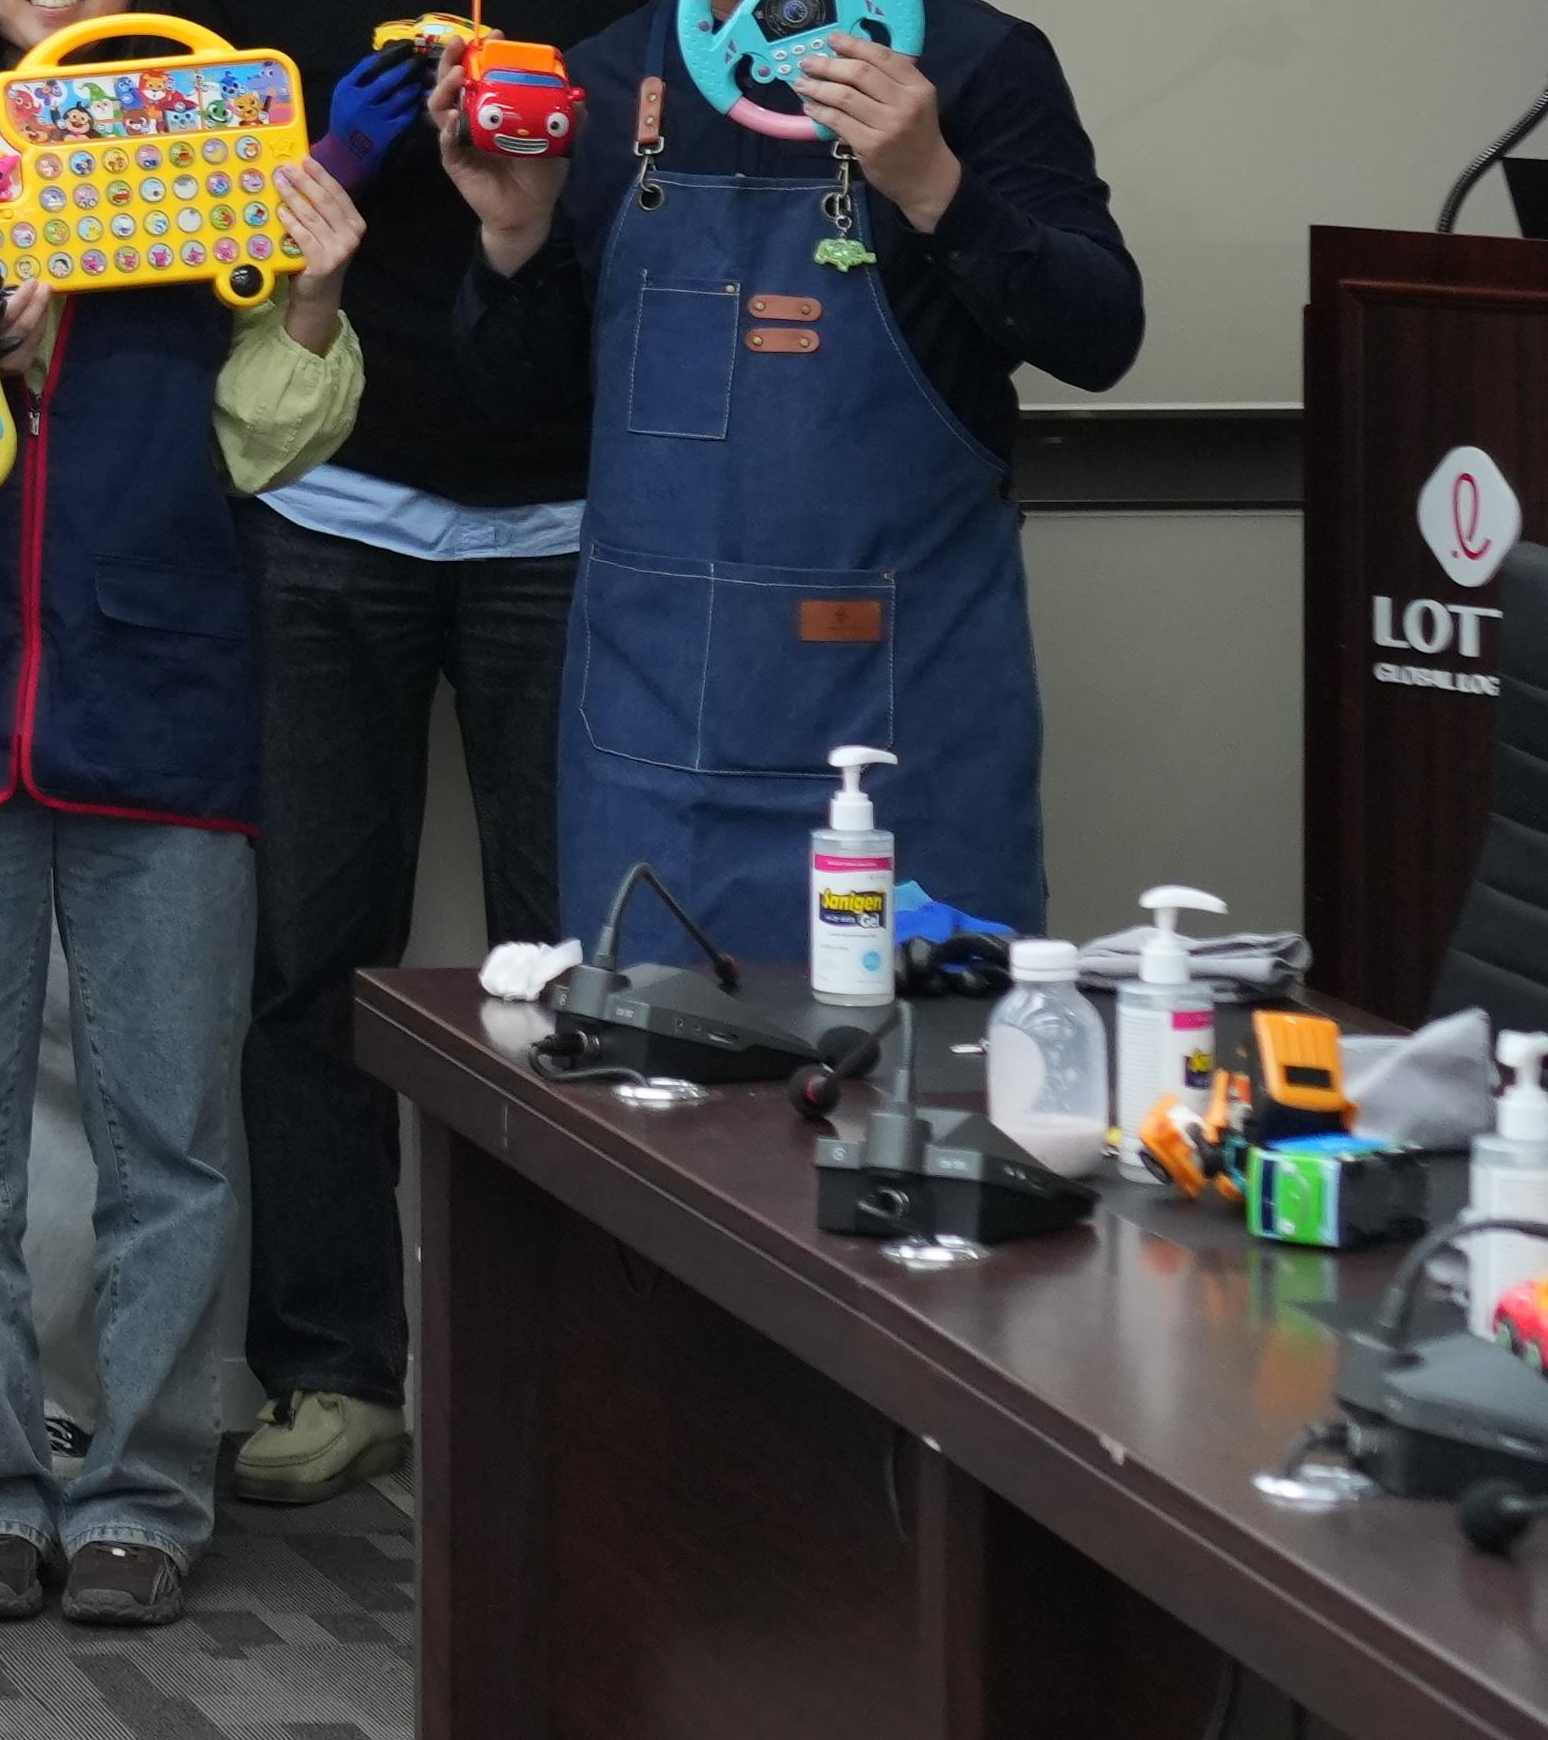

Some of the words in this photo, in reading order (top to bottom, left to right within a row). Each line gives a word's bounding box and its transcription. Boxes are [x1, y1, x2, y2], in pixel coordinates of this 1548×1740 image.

[1374, 596, 1503, 658] LOT
[822, 887, 883, 915] Sanigen
[859, 913, 880, 929] Gel
